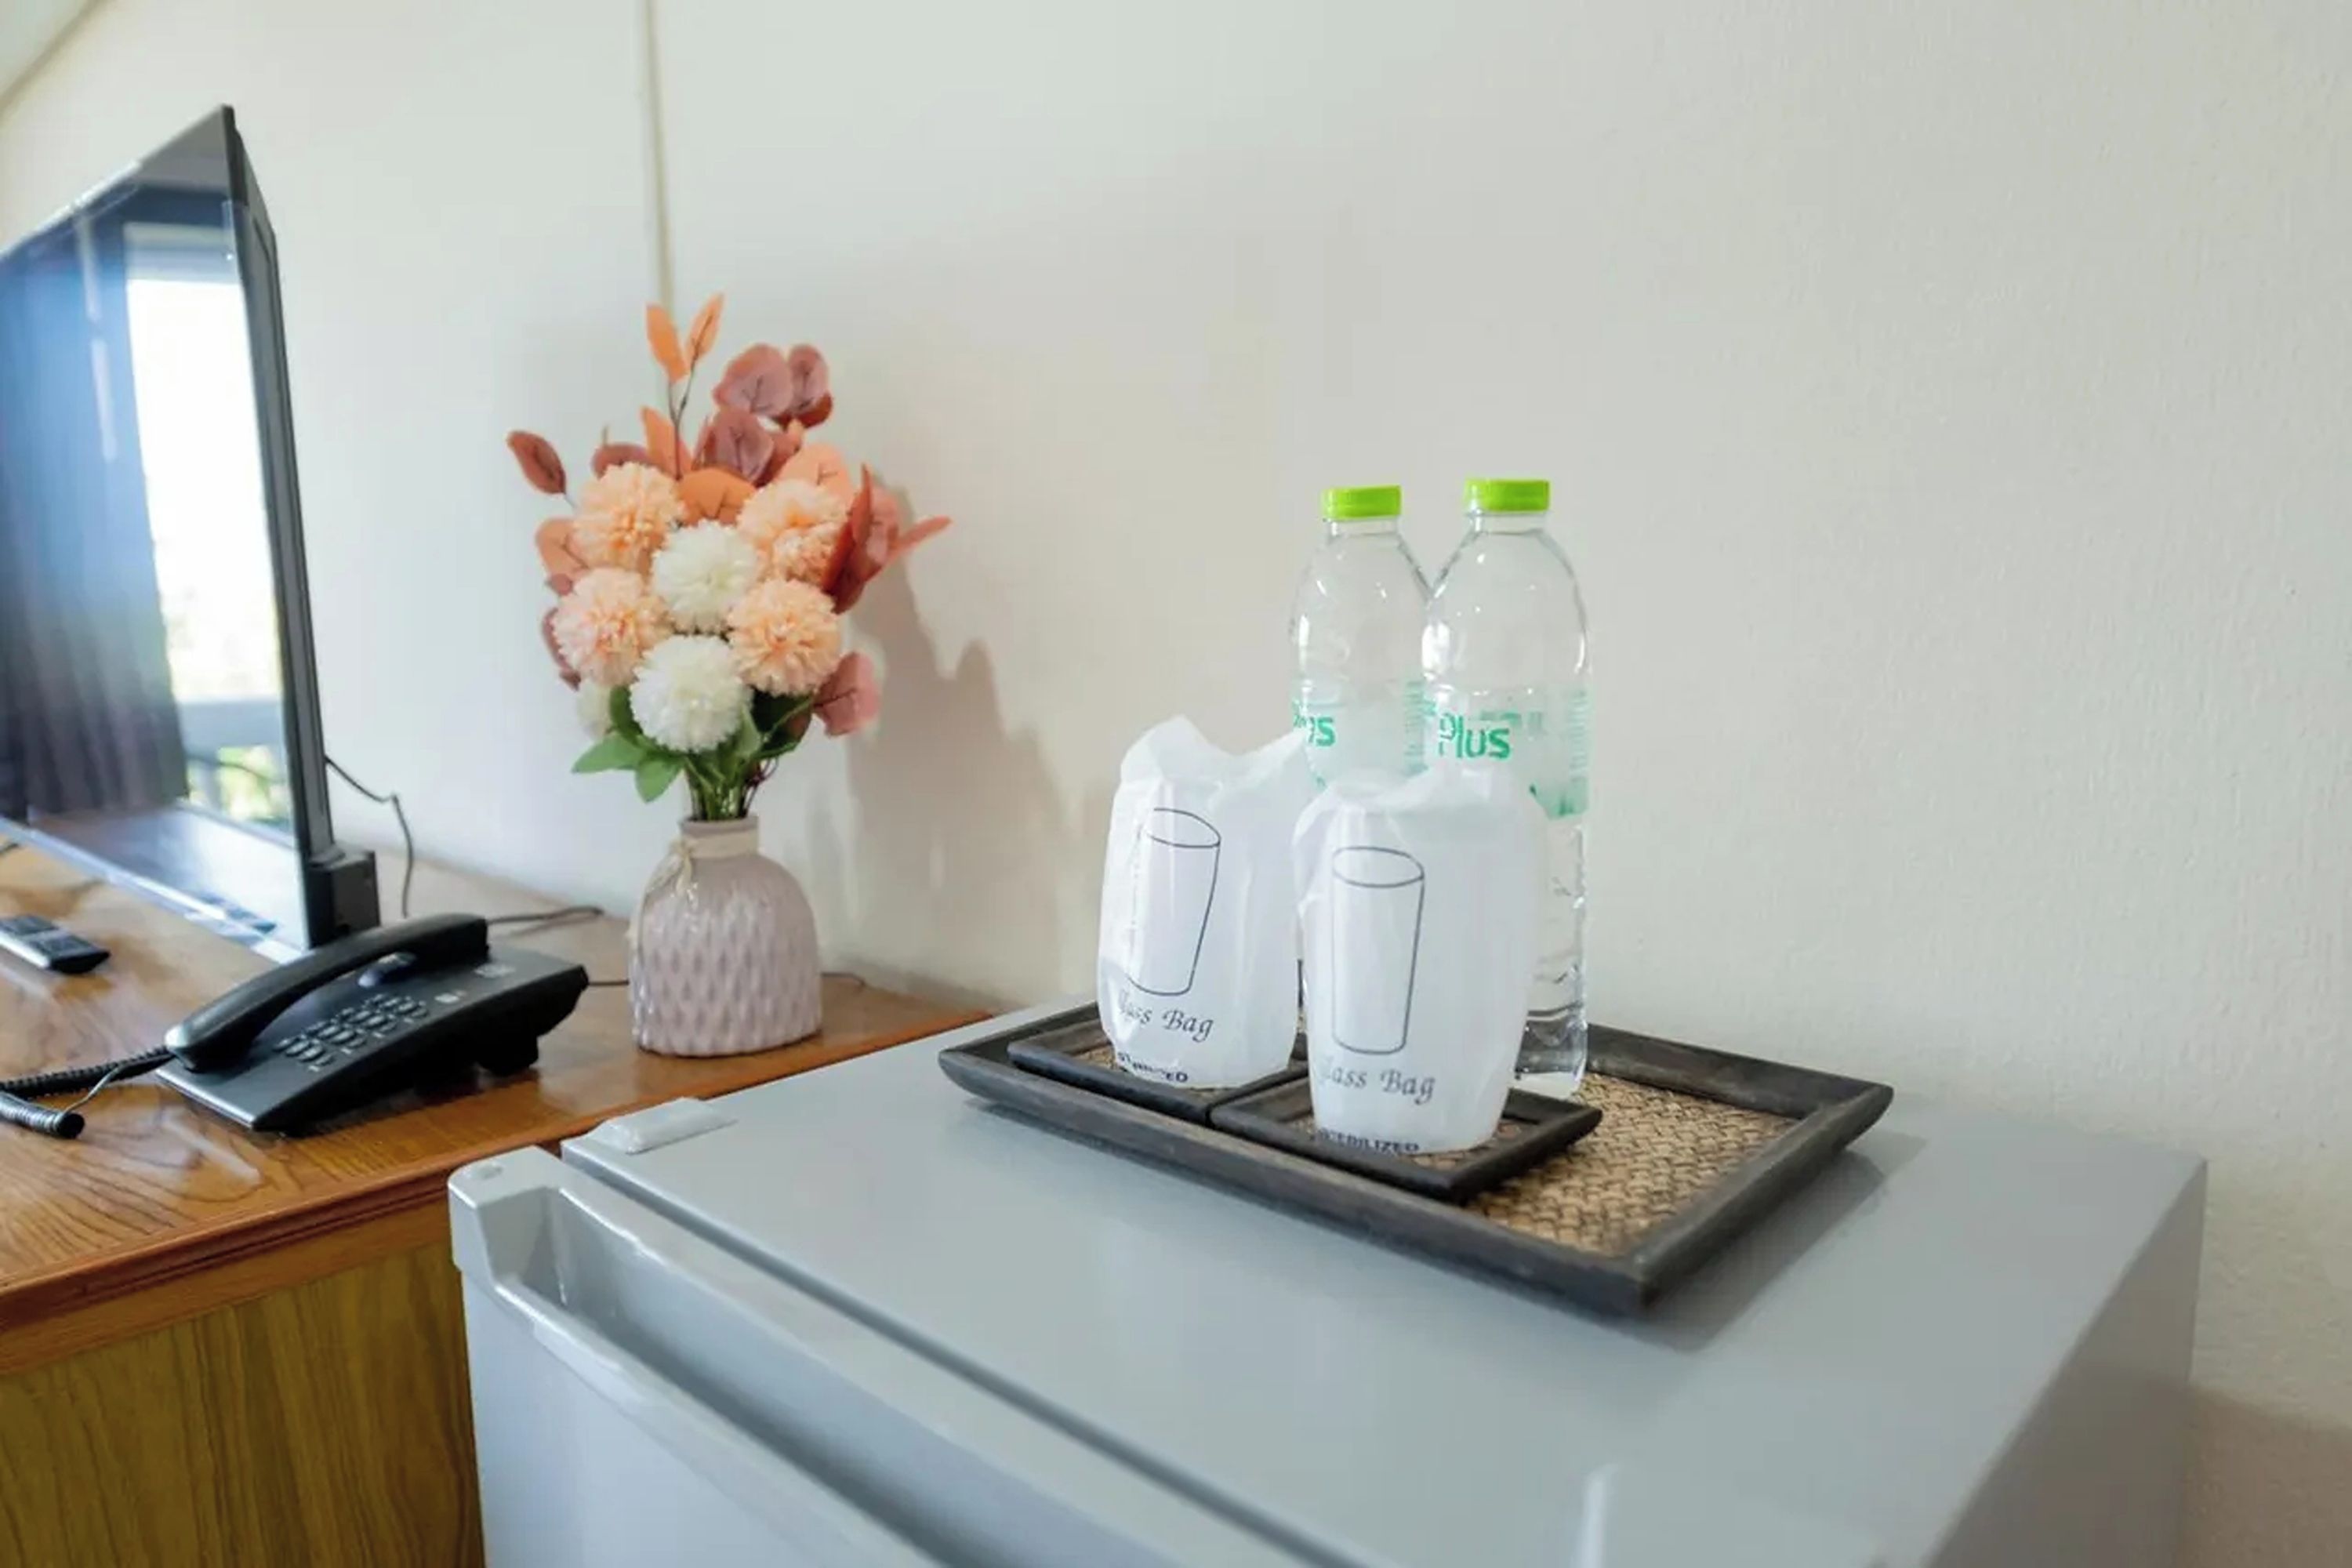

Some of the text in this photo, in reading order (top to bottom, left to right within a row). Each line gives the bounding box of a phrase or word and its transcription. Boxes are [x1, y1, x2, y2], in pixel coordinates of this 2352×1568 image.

[1439, 712, 1511, 759] Plus
[1162, 1008, 1214, 1044] Bag
[1379, 1068, 1436, 1106] Bag
